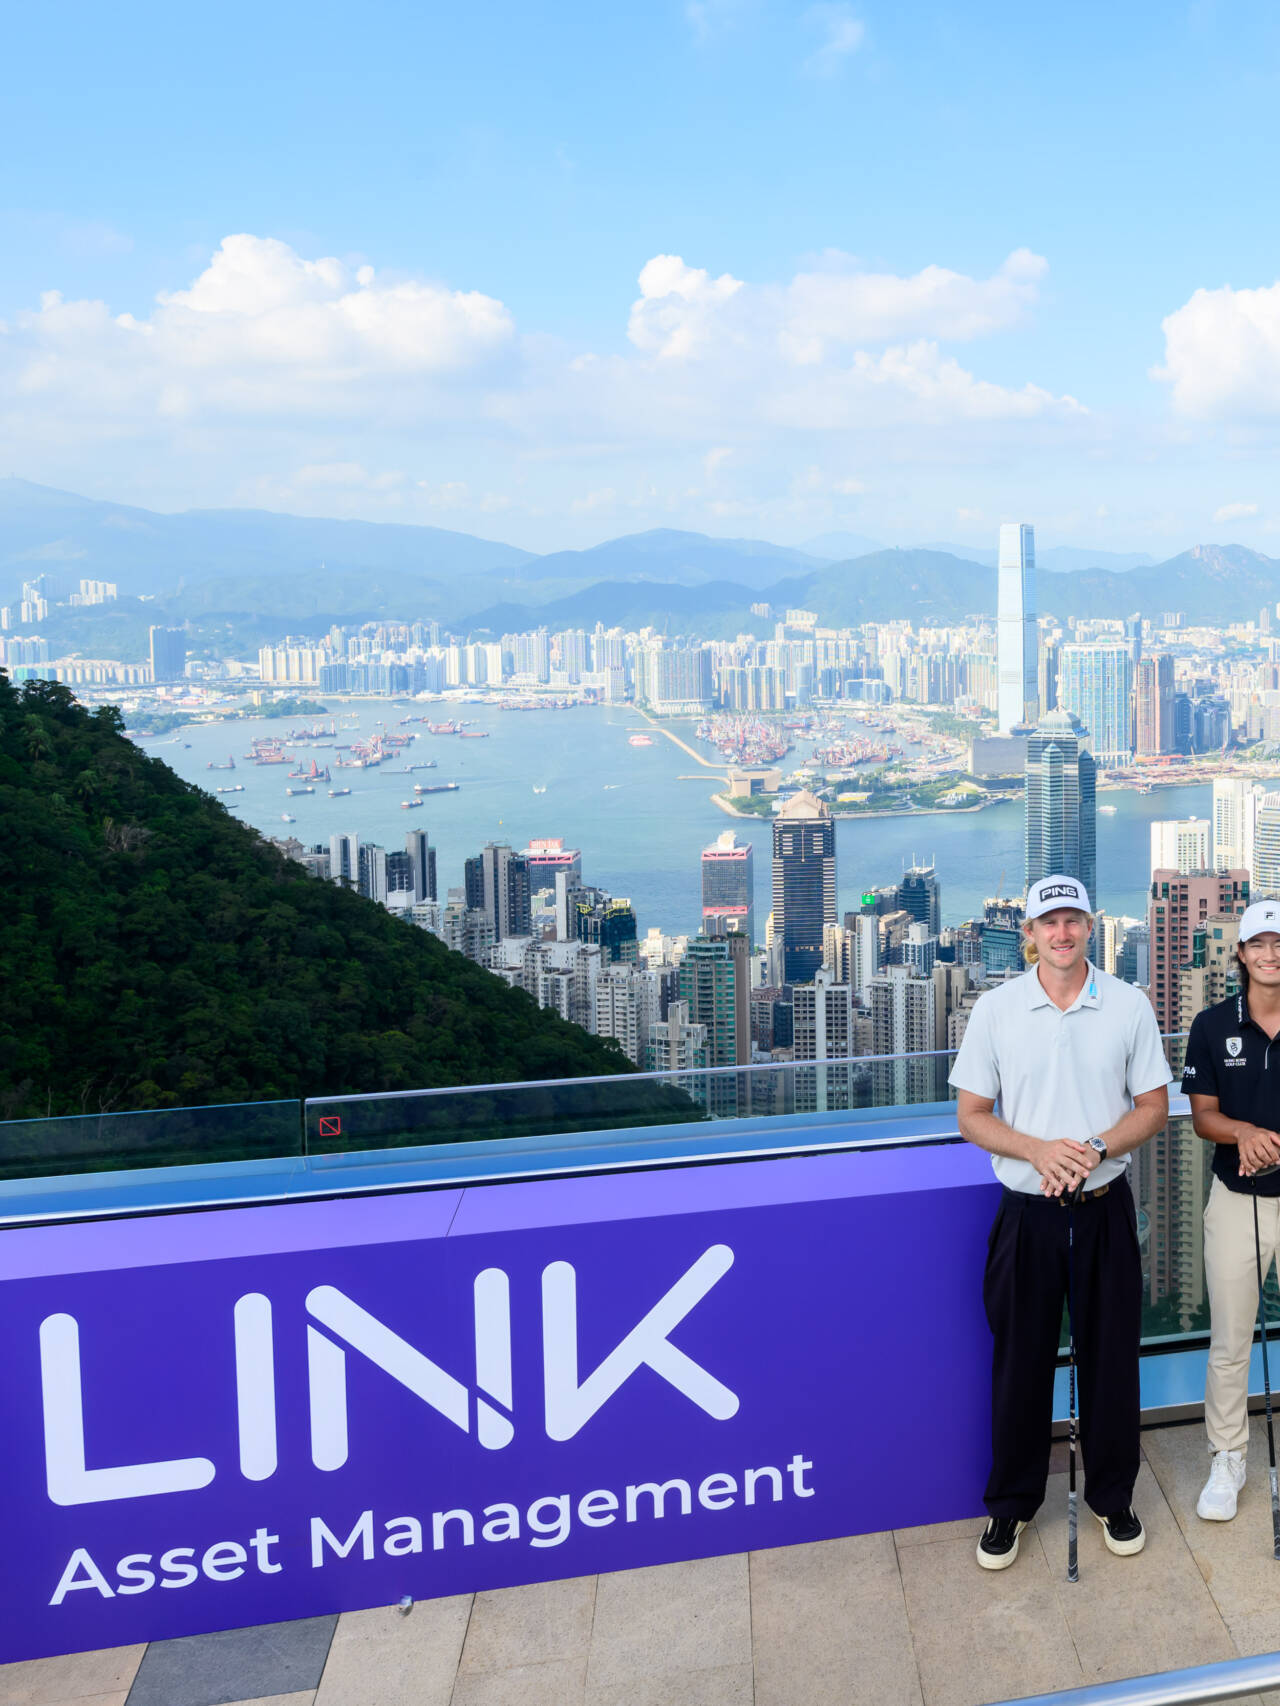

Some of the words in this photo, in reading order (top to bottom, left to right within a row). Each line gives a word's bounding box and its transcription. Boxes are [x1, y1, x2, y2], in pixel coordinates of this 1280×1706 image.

[1041, 886, 1078, 900] PING
[1183, 1066, 1196, 1075] FILA
[38, 1243, 741, 1507] LINK
[49, 1528, 283, 1606] Asset
[310, 1453, 816, 1568] Management
